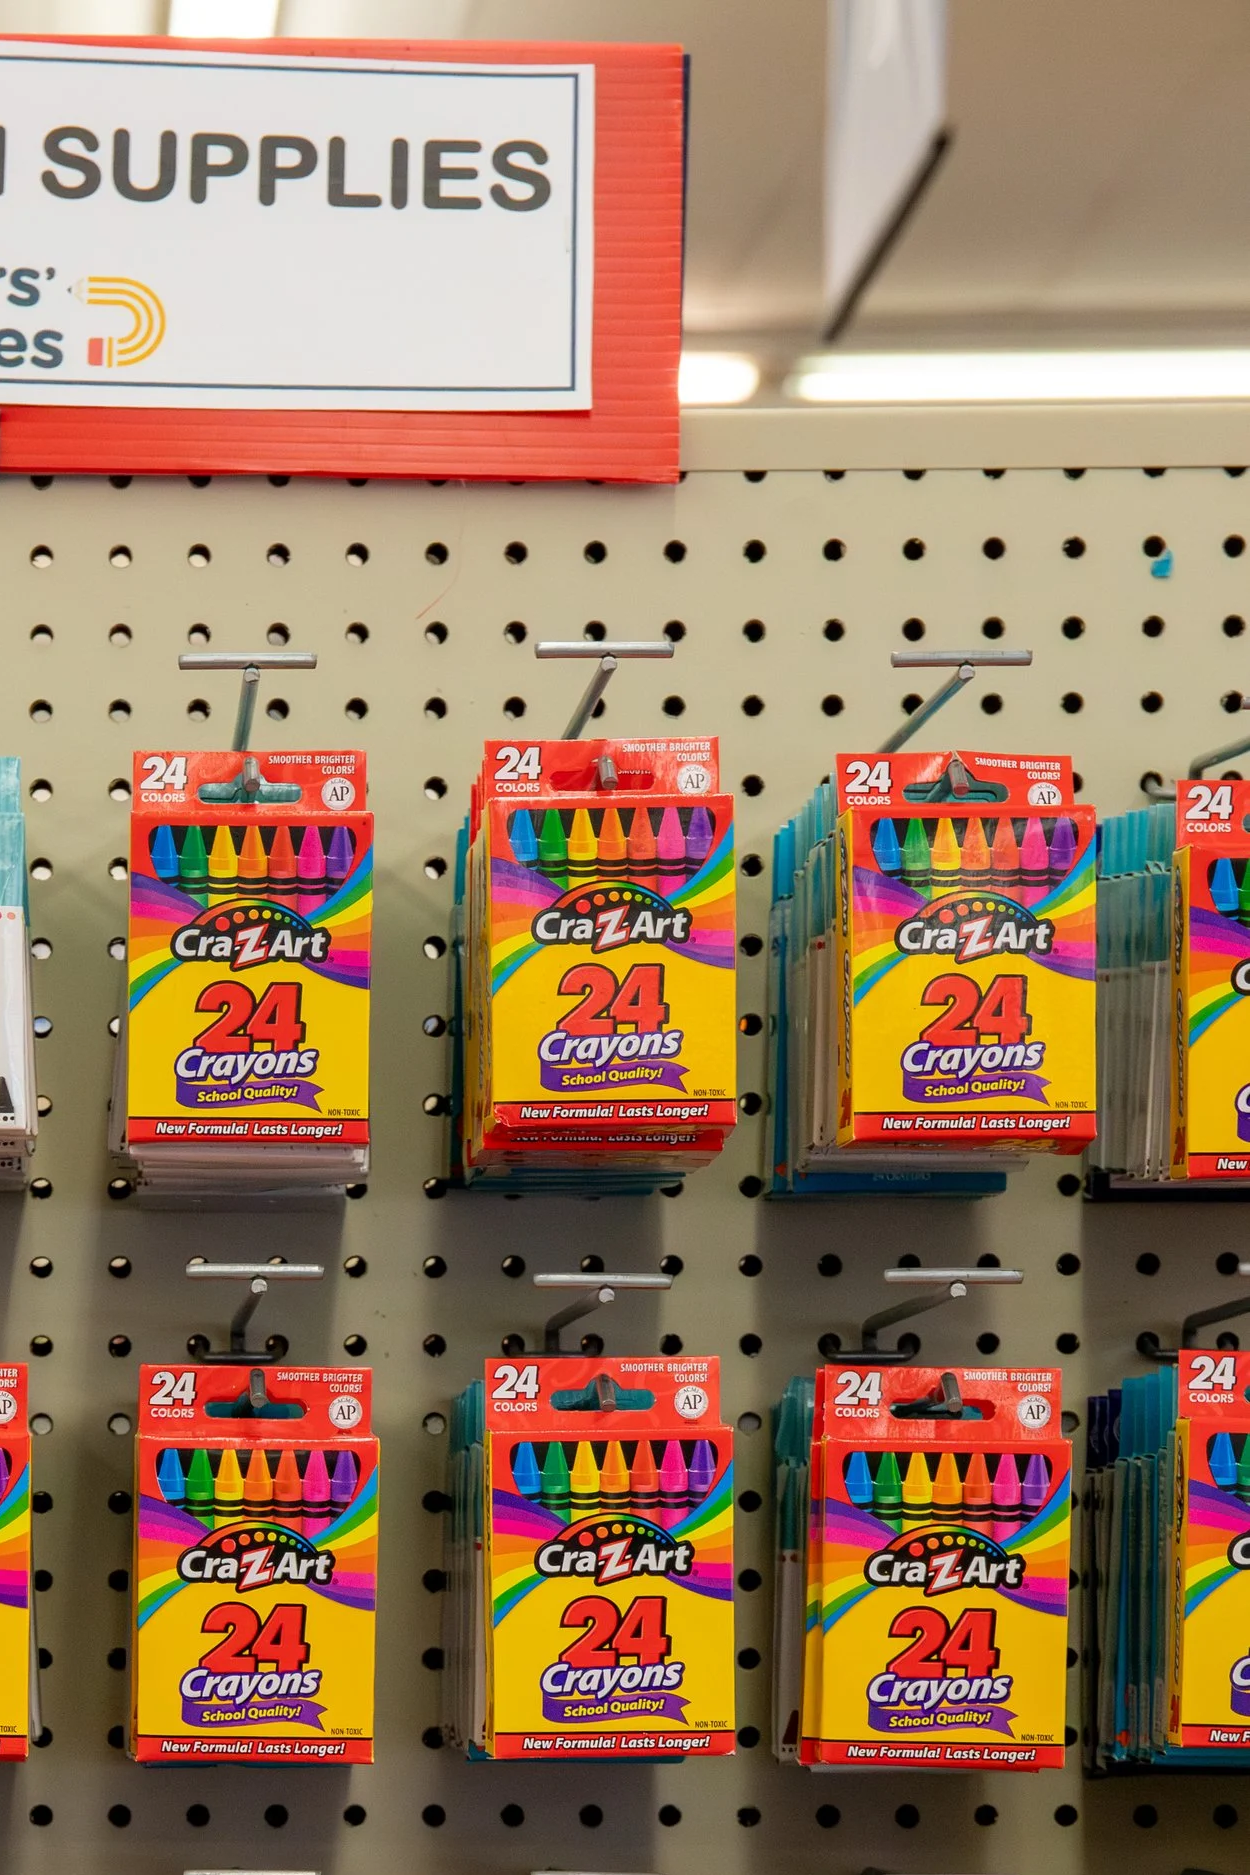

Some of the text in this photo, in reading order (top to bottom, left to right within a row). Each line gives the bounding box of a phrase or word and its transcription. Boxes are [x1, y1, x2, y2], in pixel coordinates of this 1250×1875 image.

[40, 125, 551, 213] SUPPLIES
[622, 742, 711, 753] SMOOTHER BRIGHTER
[676, 753, 711, 763] COLORS!
[140, 755, 187, 790] 24
[140, 792, 186, 803] COLORS
[1185, 785, 1232, 819] 24
[1186, 822, 1232, 833] COLORS
[175, 1048, 318, 1084] Crayons
[923, 1079, 1025, 1097] School Quality!
[1055, 1100, 1088, 1109] NON-TOXIC
[1188, 1357, 1236, 1390] 24
[1188, 1392, 1235, 1403] COLORS
[559, 1594, 672, 1667] 24
[542, 1661, 683, 1698] Crayons
[201, 1706, 302, 1722] School Quality!
[331, 1728, 363, 1736] NON-TOXIC
[847, 1746, 1036, 1763] New Formula! Lasts Longer!
